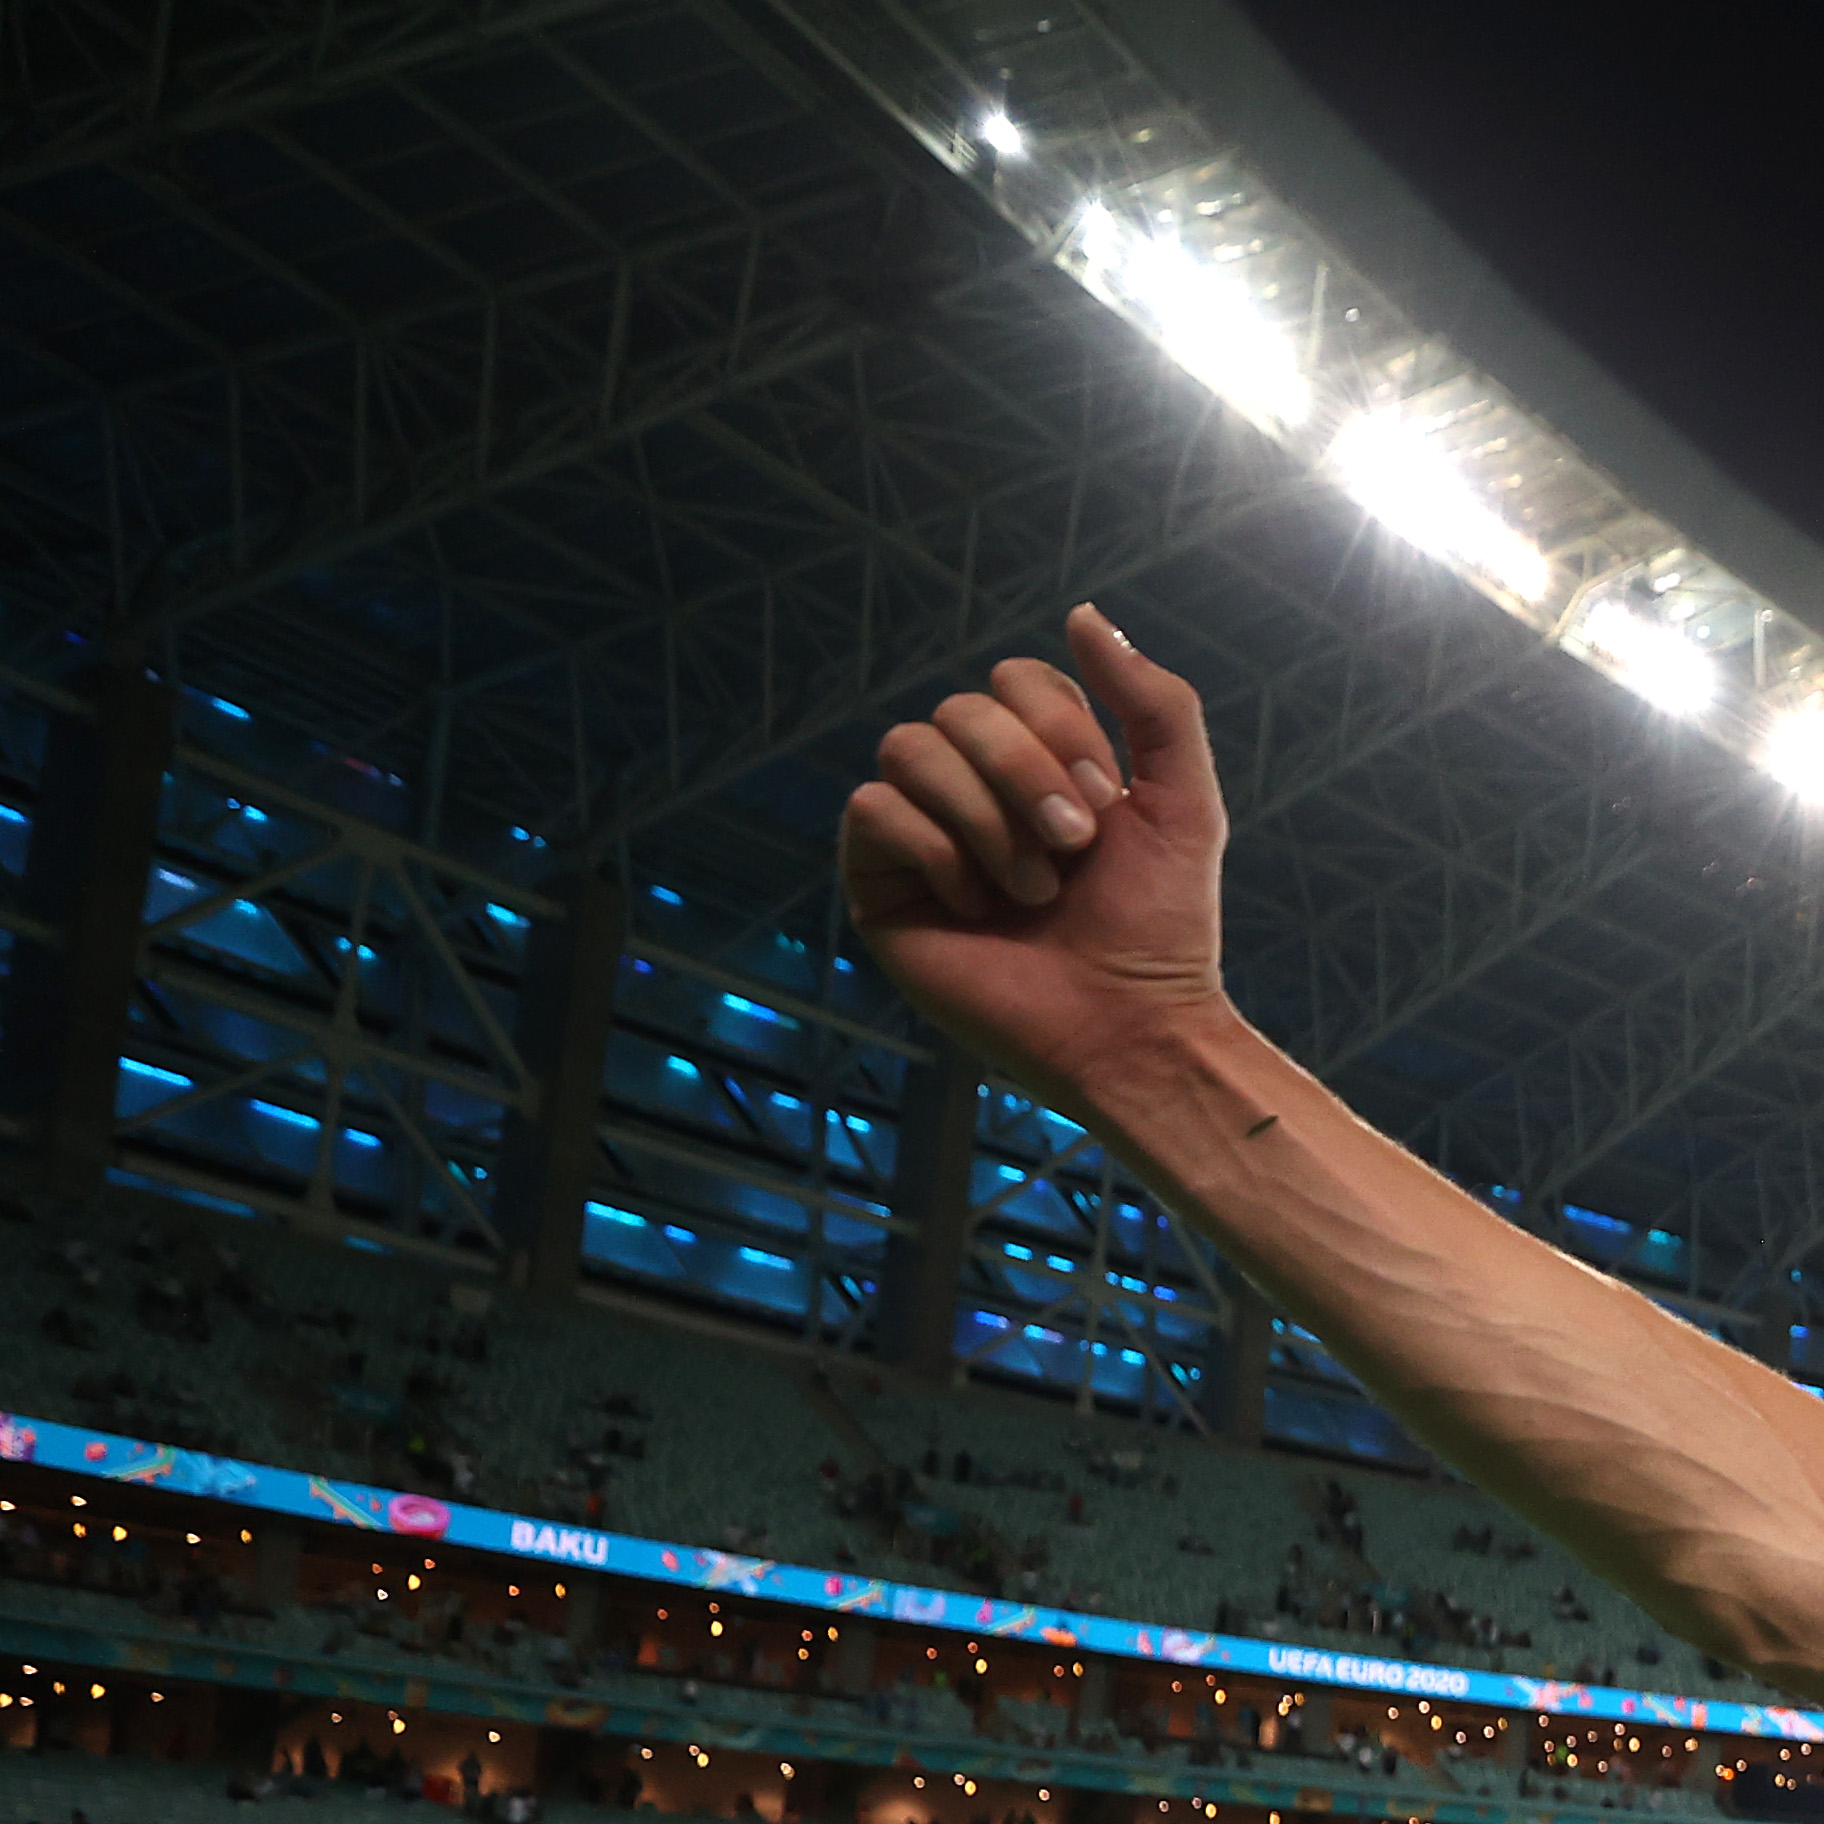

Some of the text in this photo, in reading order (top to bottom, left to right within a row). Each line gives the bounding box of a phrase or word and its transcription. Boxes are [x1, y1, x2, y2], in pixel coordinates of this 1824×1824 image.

[510, 1520, 609, 1565] BAKU
[1269, 1647, 1470, 1697] UEFA EURO 2020
